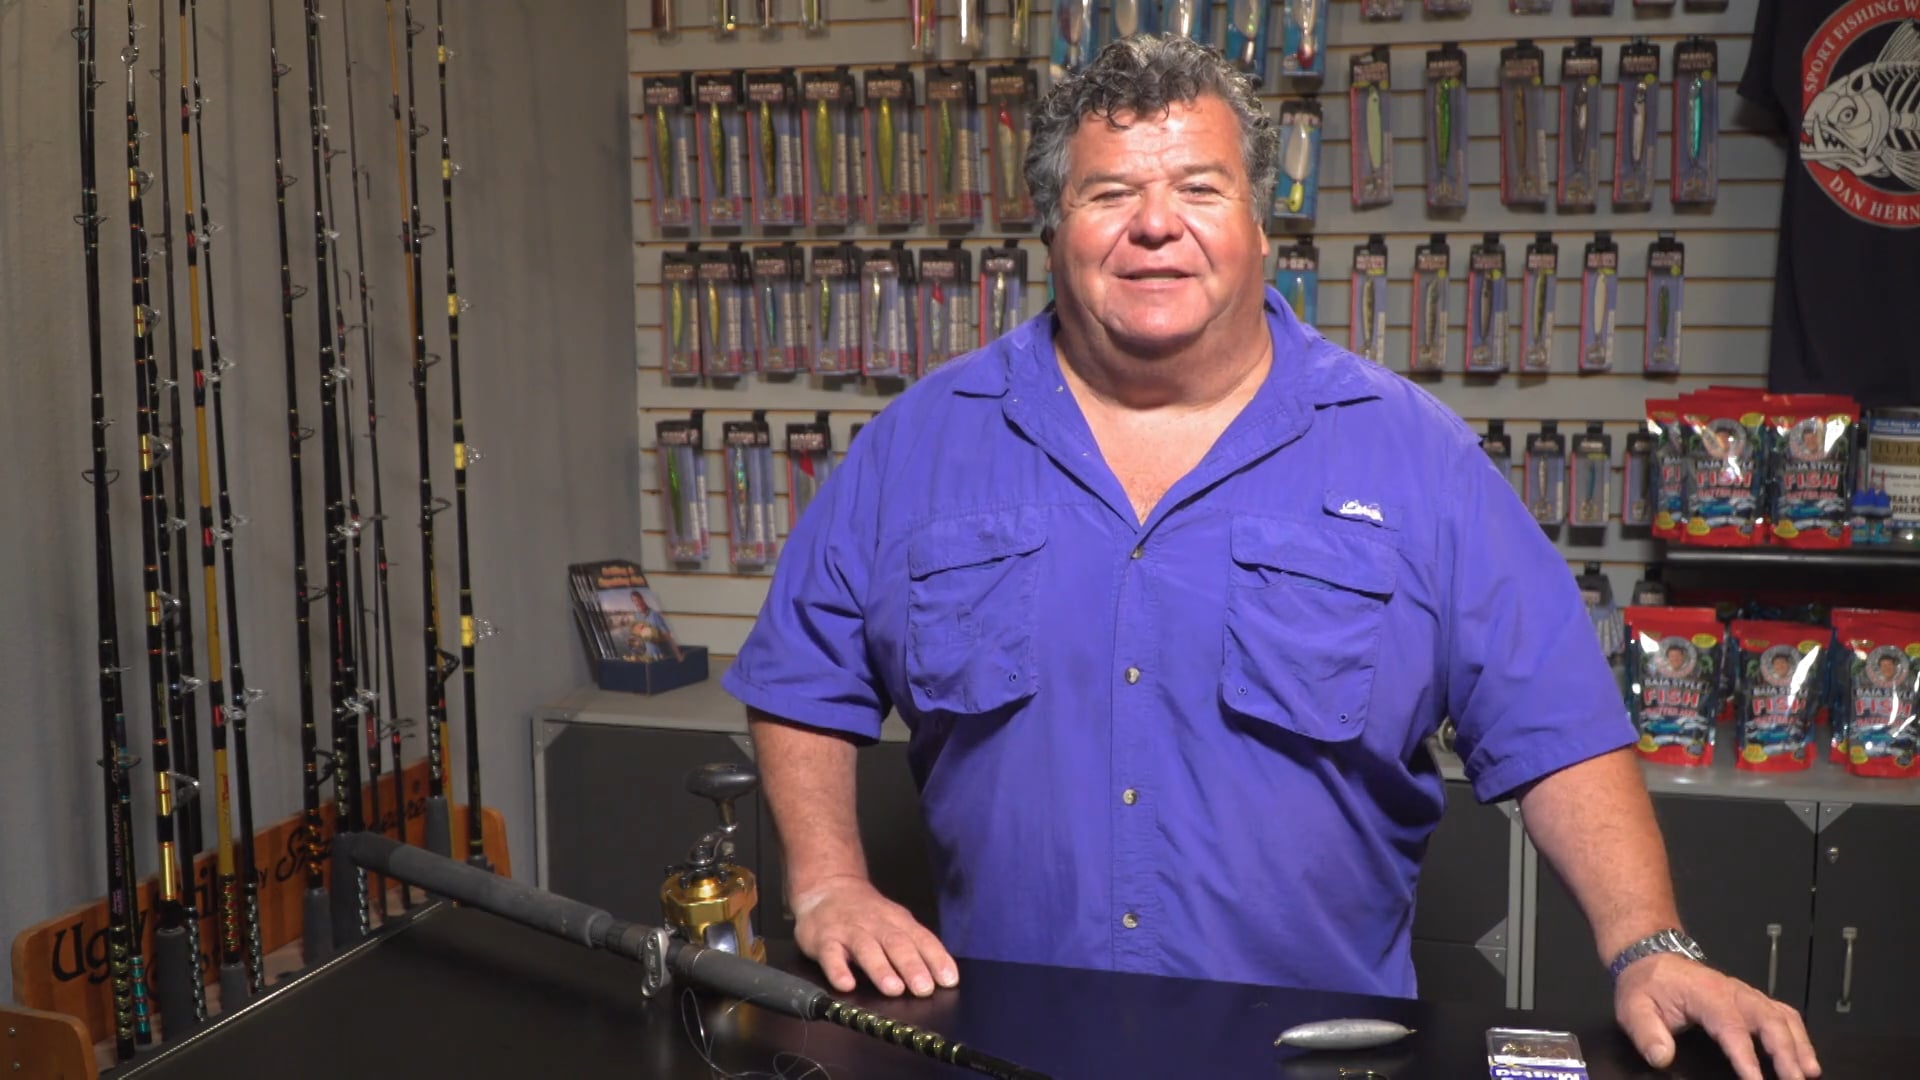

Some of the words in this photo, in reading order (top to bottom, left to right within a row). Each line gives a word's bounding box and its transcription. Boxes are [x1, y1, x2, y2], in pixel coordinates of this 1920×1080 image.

[1804, 37, 1836, 93] SPORT
[1832, 0, 1900, 40] FISHING
[1829, 175, 1867, 211] DAN
[1784, 470, 1839, 490] FISH
[1645, 678, 1670, 687] BAJA
[1643, 687, 1699, 708] FISH
[1752, 695, 1807, 717] FISH
